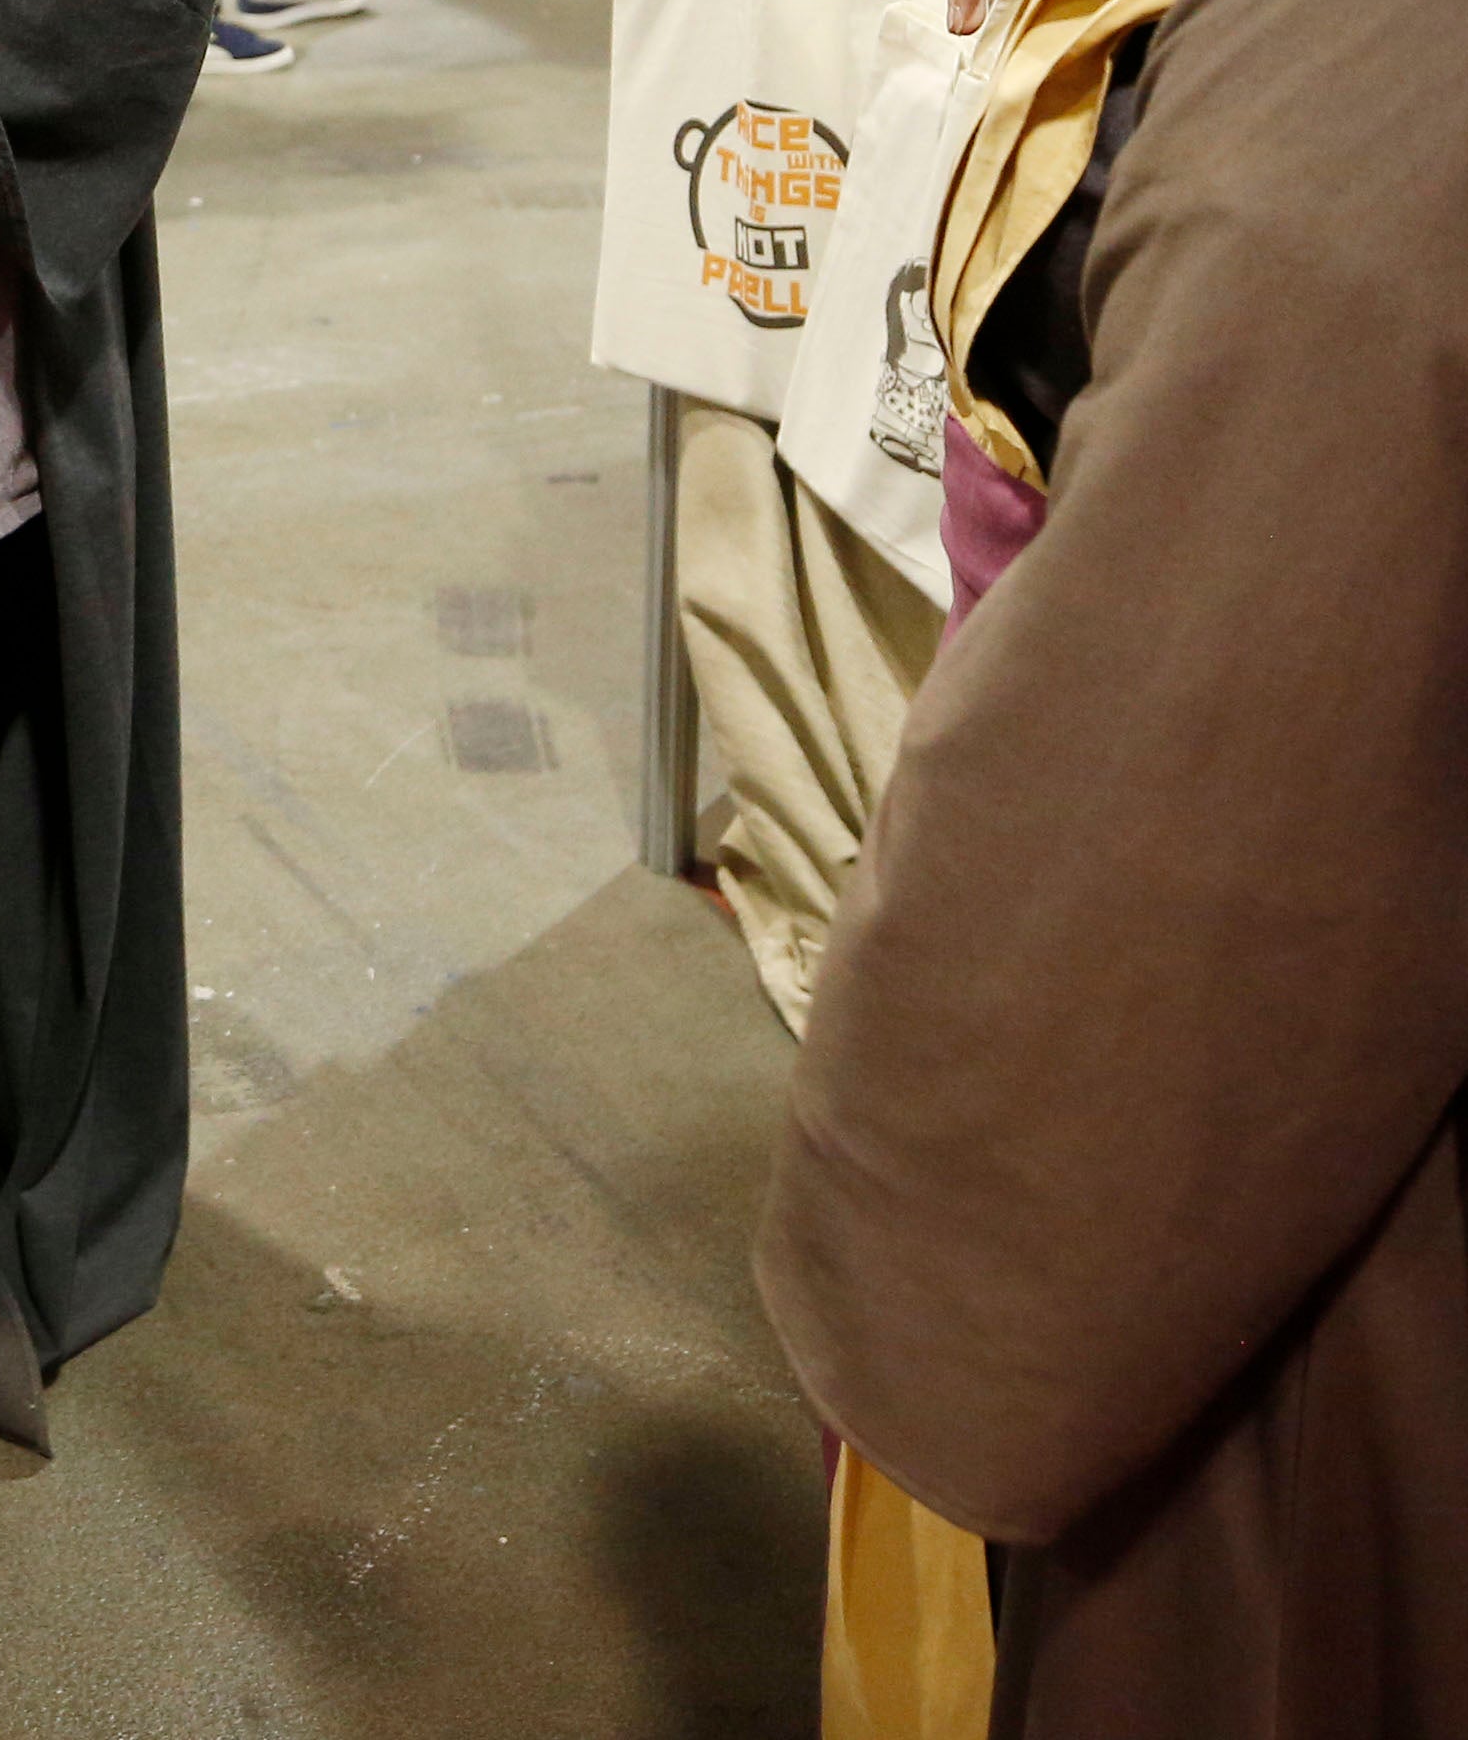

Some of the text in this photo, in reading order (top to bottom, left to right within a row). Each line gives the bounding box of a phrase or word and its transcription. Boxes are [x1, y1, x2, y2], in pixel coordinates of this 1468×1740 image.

[786, 153, 843, 171] WITH
[736, 220, 805, 267] NOT
[701, 252, 809, 316] PAELL
